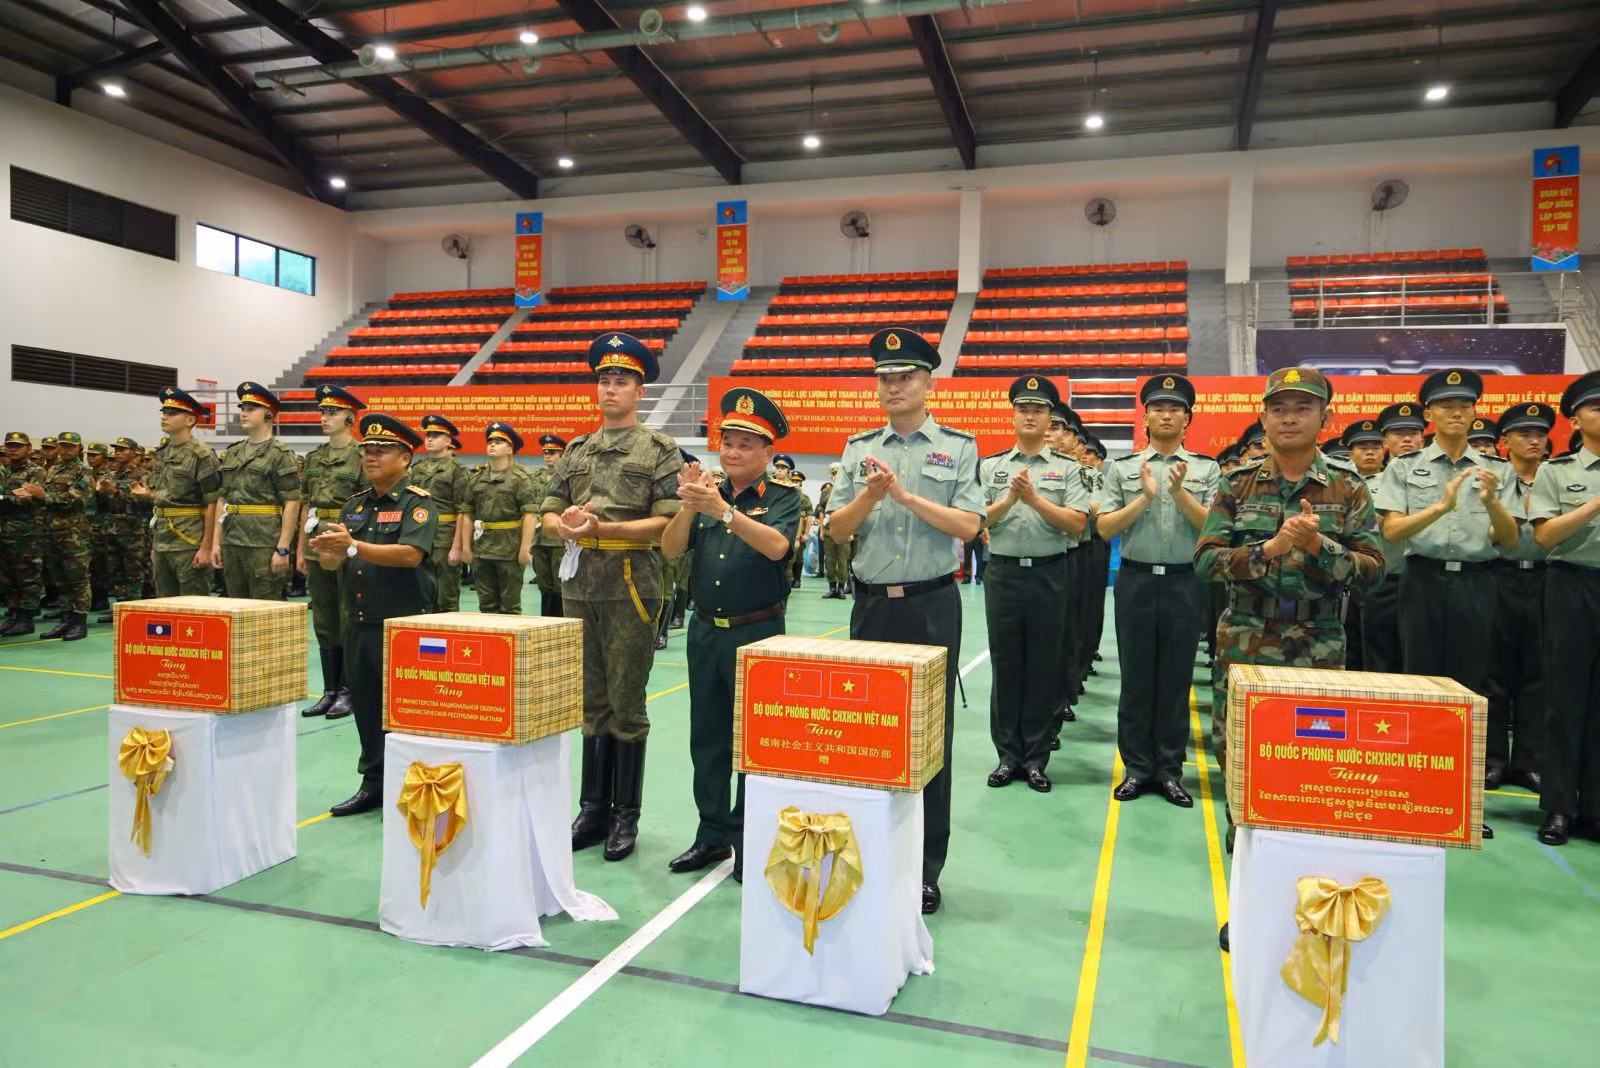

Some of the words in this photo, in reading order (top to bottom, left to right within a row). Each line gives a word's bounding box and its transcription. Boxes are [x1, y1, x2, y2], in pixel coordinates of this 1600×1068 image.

[783, 389, 795, 398] CÁC
[808, 390, 828, 399] LƯỢNG
[838, 390, 858, 398] TRANG
[953, 391, 969, 399] BINH
[970, 391, 981, 400] TẠI
[982, 388, 990, 399] LỄ
[991, 388, 999, 399] KỶ
[1207, 393, 1223, 404] LỰC
[1223, 393, 1250, 404] LƯỢNG
[1345, 392, 1364, 402] DÂN
[1365, 393, 1392, 402] TRUNG
[1393, 391, 1417, 403] QUỐC
[1482, 393, 1504, 402] BINH
[1505, 393, 1520, 404] TẠI
[1521, 390, 1533, 402] LỄ
[1534, 391, 1546, 402] KỶ
[782, 399, 801, 408] THÁNG
[802, 399, 816, 408] TÁM
[816, 399, 836, 408] THÀNH
[837, 399, 854, 408] CÔNG
[956, 400, 965, 409] XÃ
[965, 400, 977, 410] HỘI
[978, 399, 992, 409] CHỦ
[1203, 404, 1226, 414] MẠNG
[1229, 403, 1254, 413] THÁNG
[1254, 403, 1265, 413] TÁ
[1337, 403, 1360, 414] QUỐC
[125, 643, 133, 655] BỘ
[133, 643, 146, 656] QUỐC
[147, 644, 164, 656] PHÒNG
[179, 648, 199, 659] CHXHCN
[199, 648, 210, 662] VIỆT
[211, 650, 223, 660] NAM
[396, 666, 403, 680] BỘ
[404, 666, 418, 680] QUỐC
[419, 668, 438, 682] PHÒNG
[438, 669, 454, 683] NƯỚC
[455, 672, 477, 685] CHXHCN
[478, 673, 491, 688] VIỆT
[491, 675, 505, 687] NAM
[434, 684, 463, 698] Tặng
[753, 701, 764, 718] BỘ
[765, 700, 784, 717] QUỐC
[785, 704, 809, 720] PHÒNG
[811, 706, 831, 721] NƯỚC
[832, 709, 863, 725] CHXHCN
[864, 711, 880, 728] VIỆT
[881, 714, 899, 728] NAM
[804, 723, 843, 739] Tặng
[759, 737, 892, 759] 越南社会主义共和国国防部
[1259, 741, 1273, 761] BỘ
[1274, 741, 1300, 760] QUỐC
[1302, 744, 1334, 763] PHÒNG
[1336, 747, 1363, 765] NƯỚC
[1365, 751, 1405, 768] CHXHCN
[1407, 752, 1429, 772] VIỆT
[1430, 756, 1455, 771] NAM
[1328, 766, 1379, 785] Tặng
